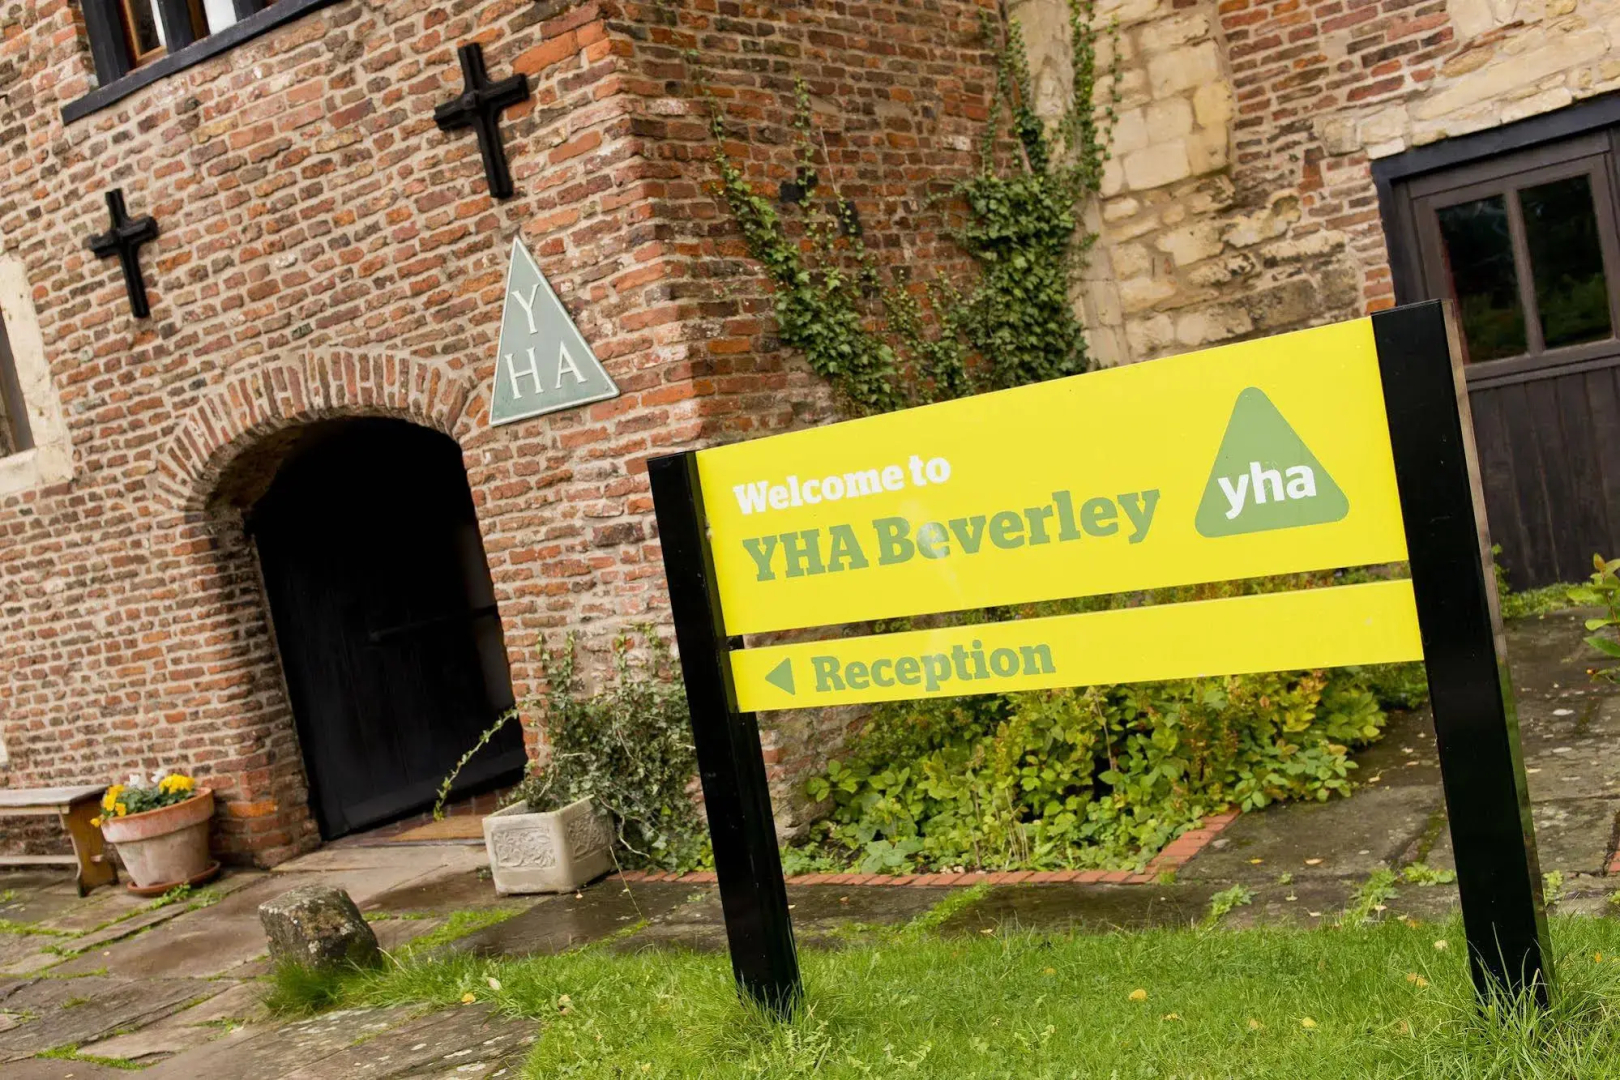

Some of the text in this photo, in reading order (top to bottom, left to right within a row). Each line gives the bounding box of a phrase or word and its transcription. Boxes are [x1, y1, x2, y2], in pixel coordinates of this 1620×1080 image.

[732, 454, 951, 515] Welcome to
[1217, 461, 1317, 520] yha
[742, 488, 1161, 582] YHA Beverley
[811, 639, 1056, 693] Reception
